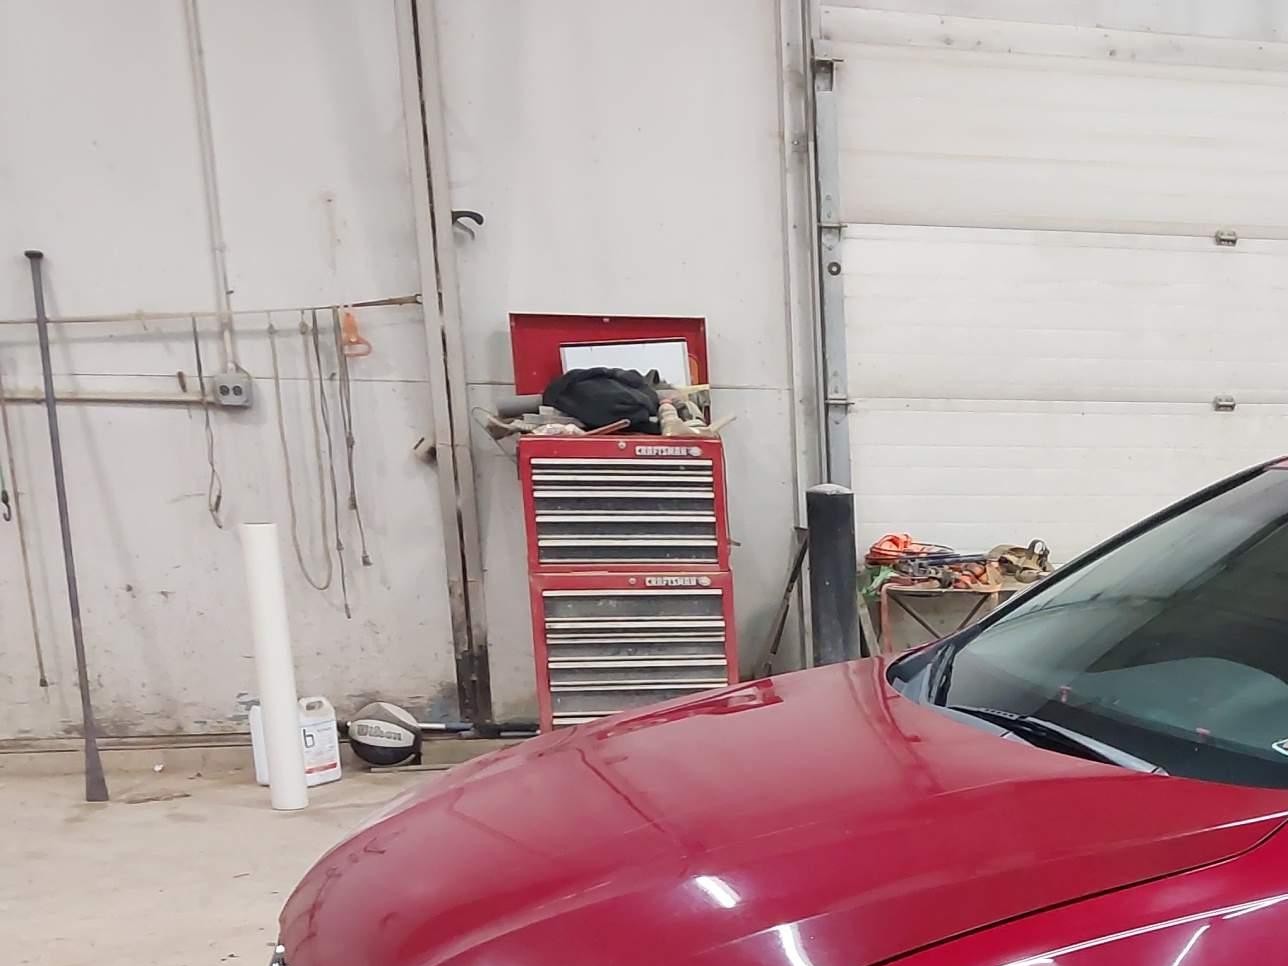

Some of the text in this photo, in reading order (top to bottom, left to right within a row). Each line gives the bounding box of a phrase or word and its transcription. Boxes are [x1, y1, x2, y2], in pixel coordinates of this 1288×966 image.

[636, 446, 688, 456] CRAFTSMAN
[645, 577, 697, 587] CRAFTSMAN
[357, 724, 402, 742] Wilson
